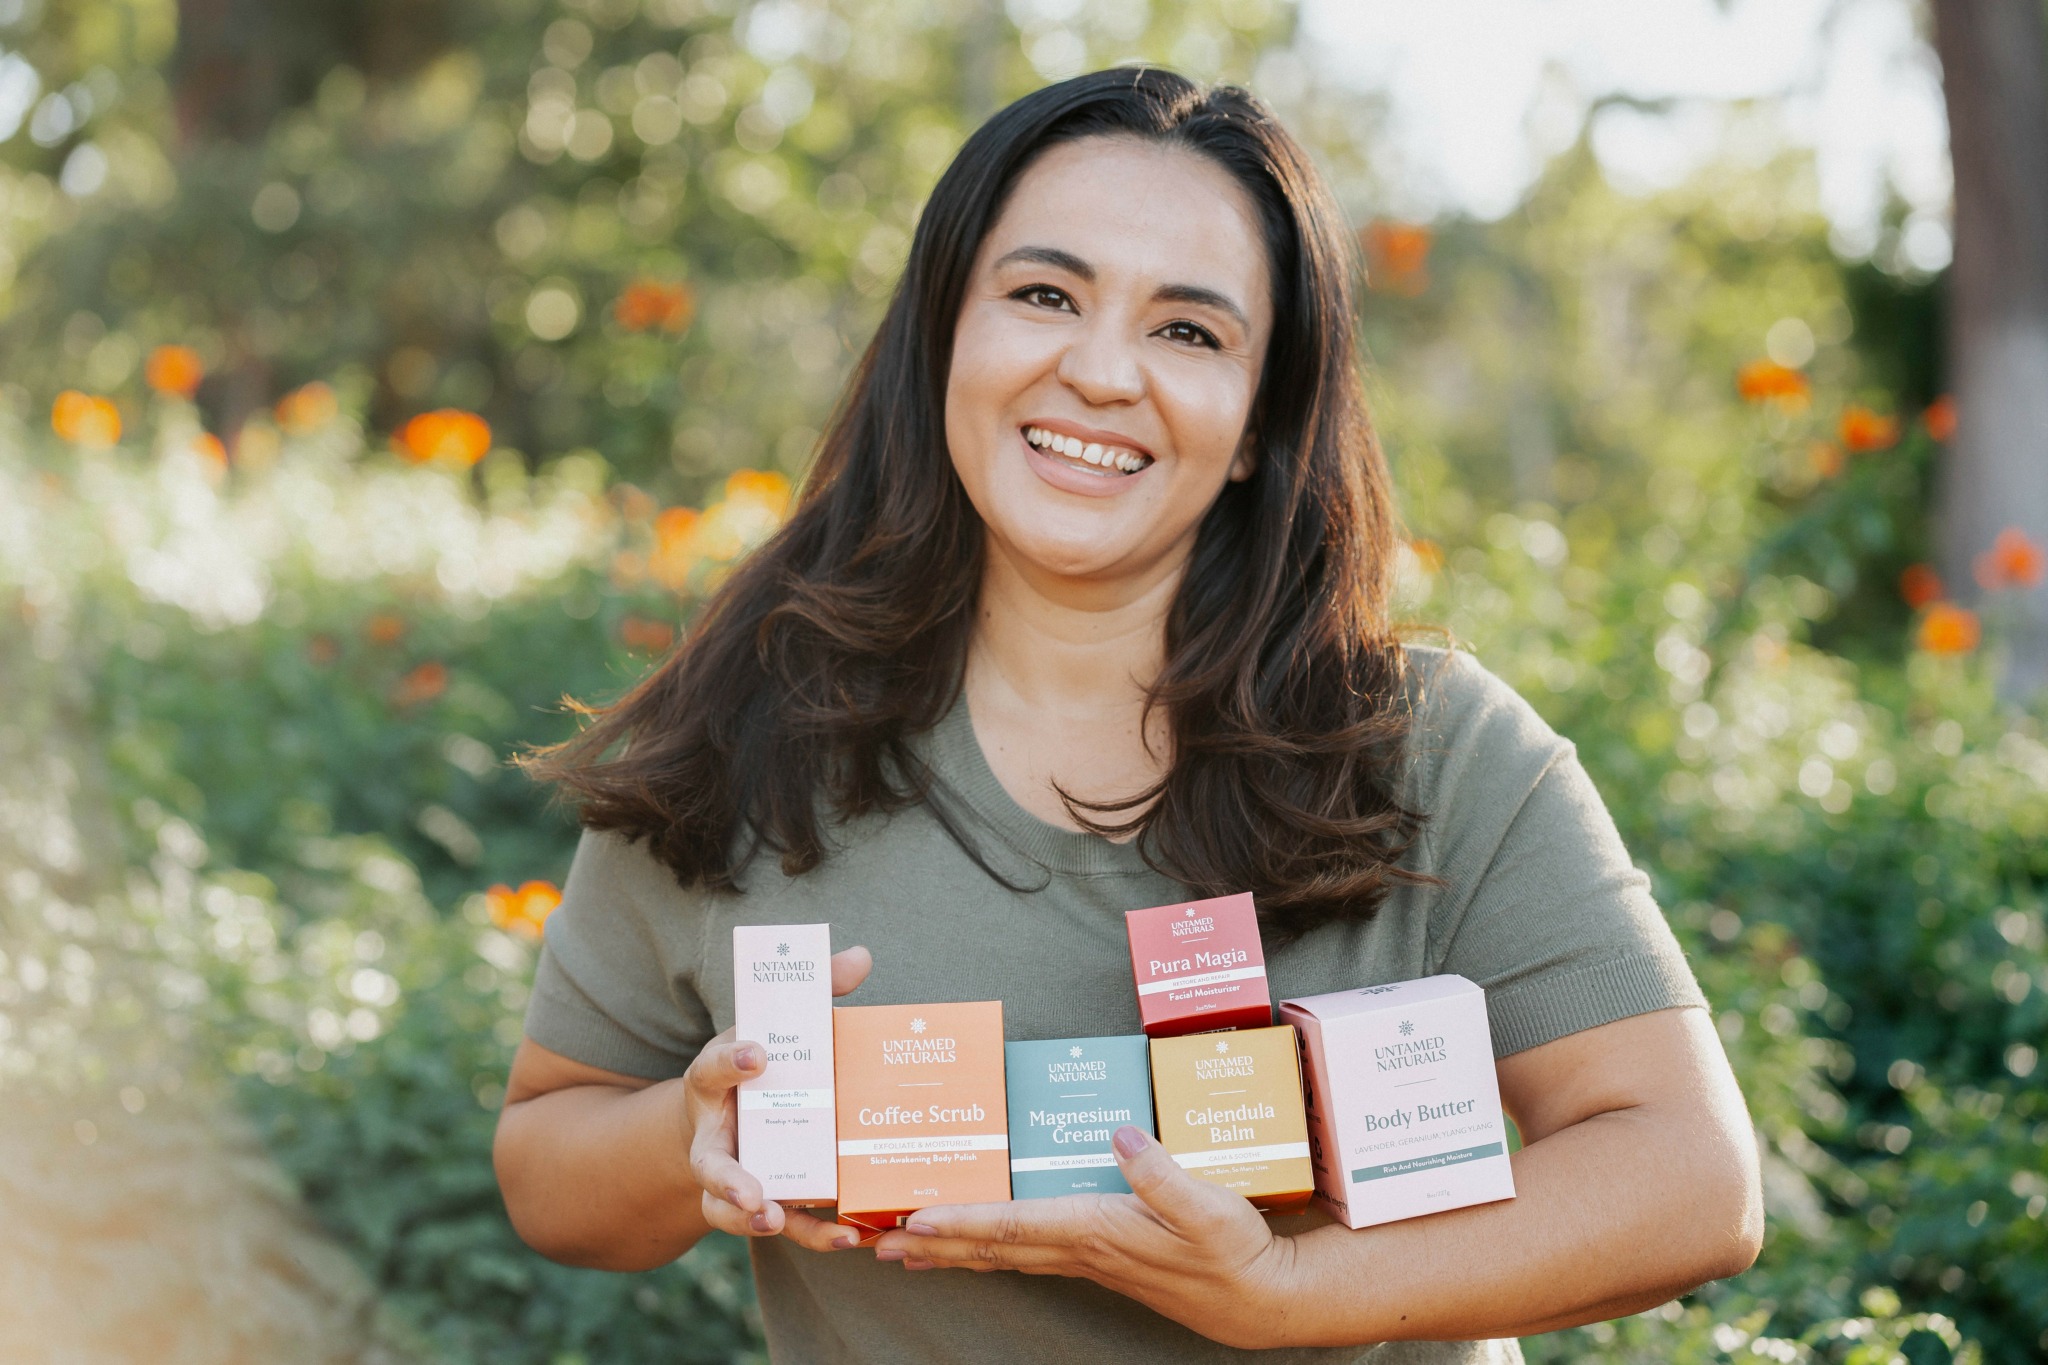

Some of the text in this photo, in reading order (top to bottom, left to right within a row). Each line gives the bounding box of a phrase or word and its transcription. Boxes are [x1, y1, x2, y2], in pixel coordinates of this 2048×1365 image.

[1171, 917, 1213, 930] UNTAMED
[1172, 923, 1215, 937] NATURALS
[753, 961, 815, 972] UNTAMED
[1149, 948, 1248, 976] Pura Magia
[753, 972, 815, 983] NATURALS
[1172, 973, 1231, 987] RESTORE AND REPAIR
[1168, 984, 1241, 1001] Facial Moisturizer
[768, 1032, 799, 1044] Rose
[882, 1038, 956, 1053] UNTAMED
[766, 1049, 812, 1062] ace Oil
[1374, 1036, 1445, 1060] UNTAMED
[883, 1050, 956, 1065] NATURALS
[1195, 1056, 1254, 1071] UNTAMED
[1376, 1048, 1448, 1074] NATURALS
[1048, 1061, 1107, 1073] UNTAMED
[1196, 1065, 1255, 1081] NATURALS
[1049, 1071, 1107, 1083] NATURALS
[762, 1091, 809, 1099] Nutrient-Rich
[765, 1118, 787, 1126] Rosehip
[792, 1118, 809, 1126] Jojoba
[858, 1103, 986, 1126] Coffee Scrub
[1029, 1107, 1132, 1129] Magnesium
[1185, 1102, 1276, 1127] Calendula
[1364, 1099, 1476, 1133] Body Butter
[1052, 1128, 1111, 1144] Cream
[1210, 1125, 1255, 1144] Balm
[1354, 1121, 1494, 1155] LAVENDER, GERANIUM, YLANG YLANG
[873, 1142, 916, 1151] EXFOLIATE
[924, 1139, 973, 1149] MOISTURIZE
[870, 1153, 977, 1165] Skin Awakening Body Polish
[1208, 1154, 1228, 1163] CALM
[1234, 1151, 1263, 1159] SOOTHE
[1383, 1152, 1473, 1174] Rich And Nourishing Moisture
[1203, 1169, 1215, 1177] One
[1241, 1166, 1256, 1174] Many
